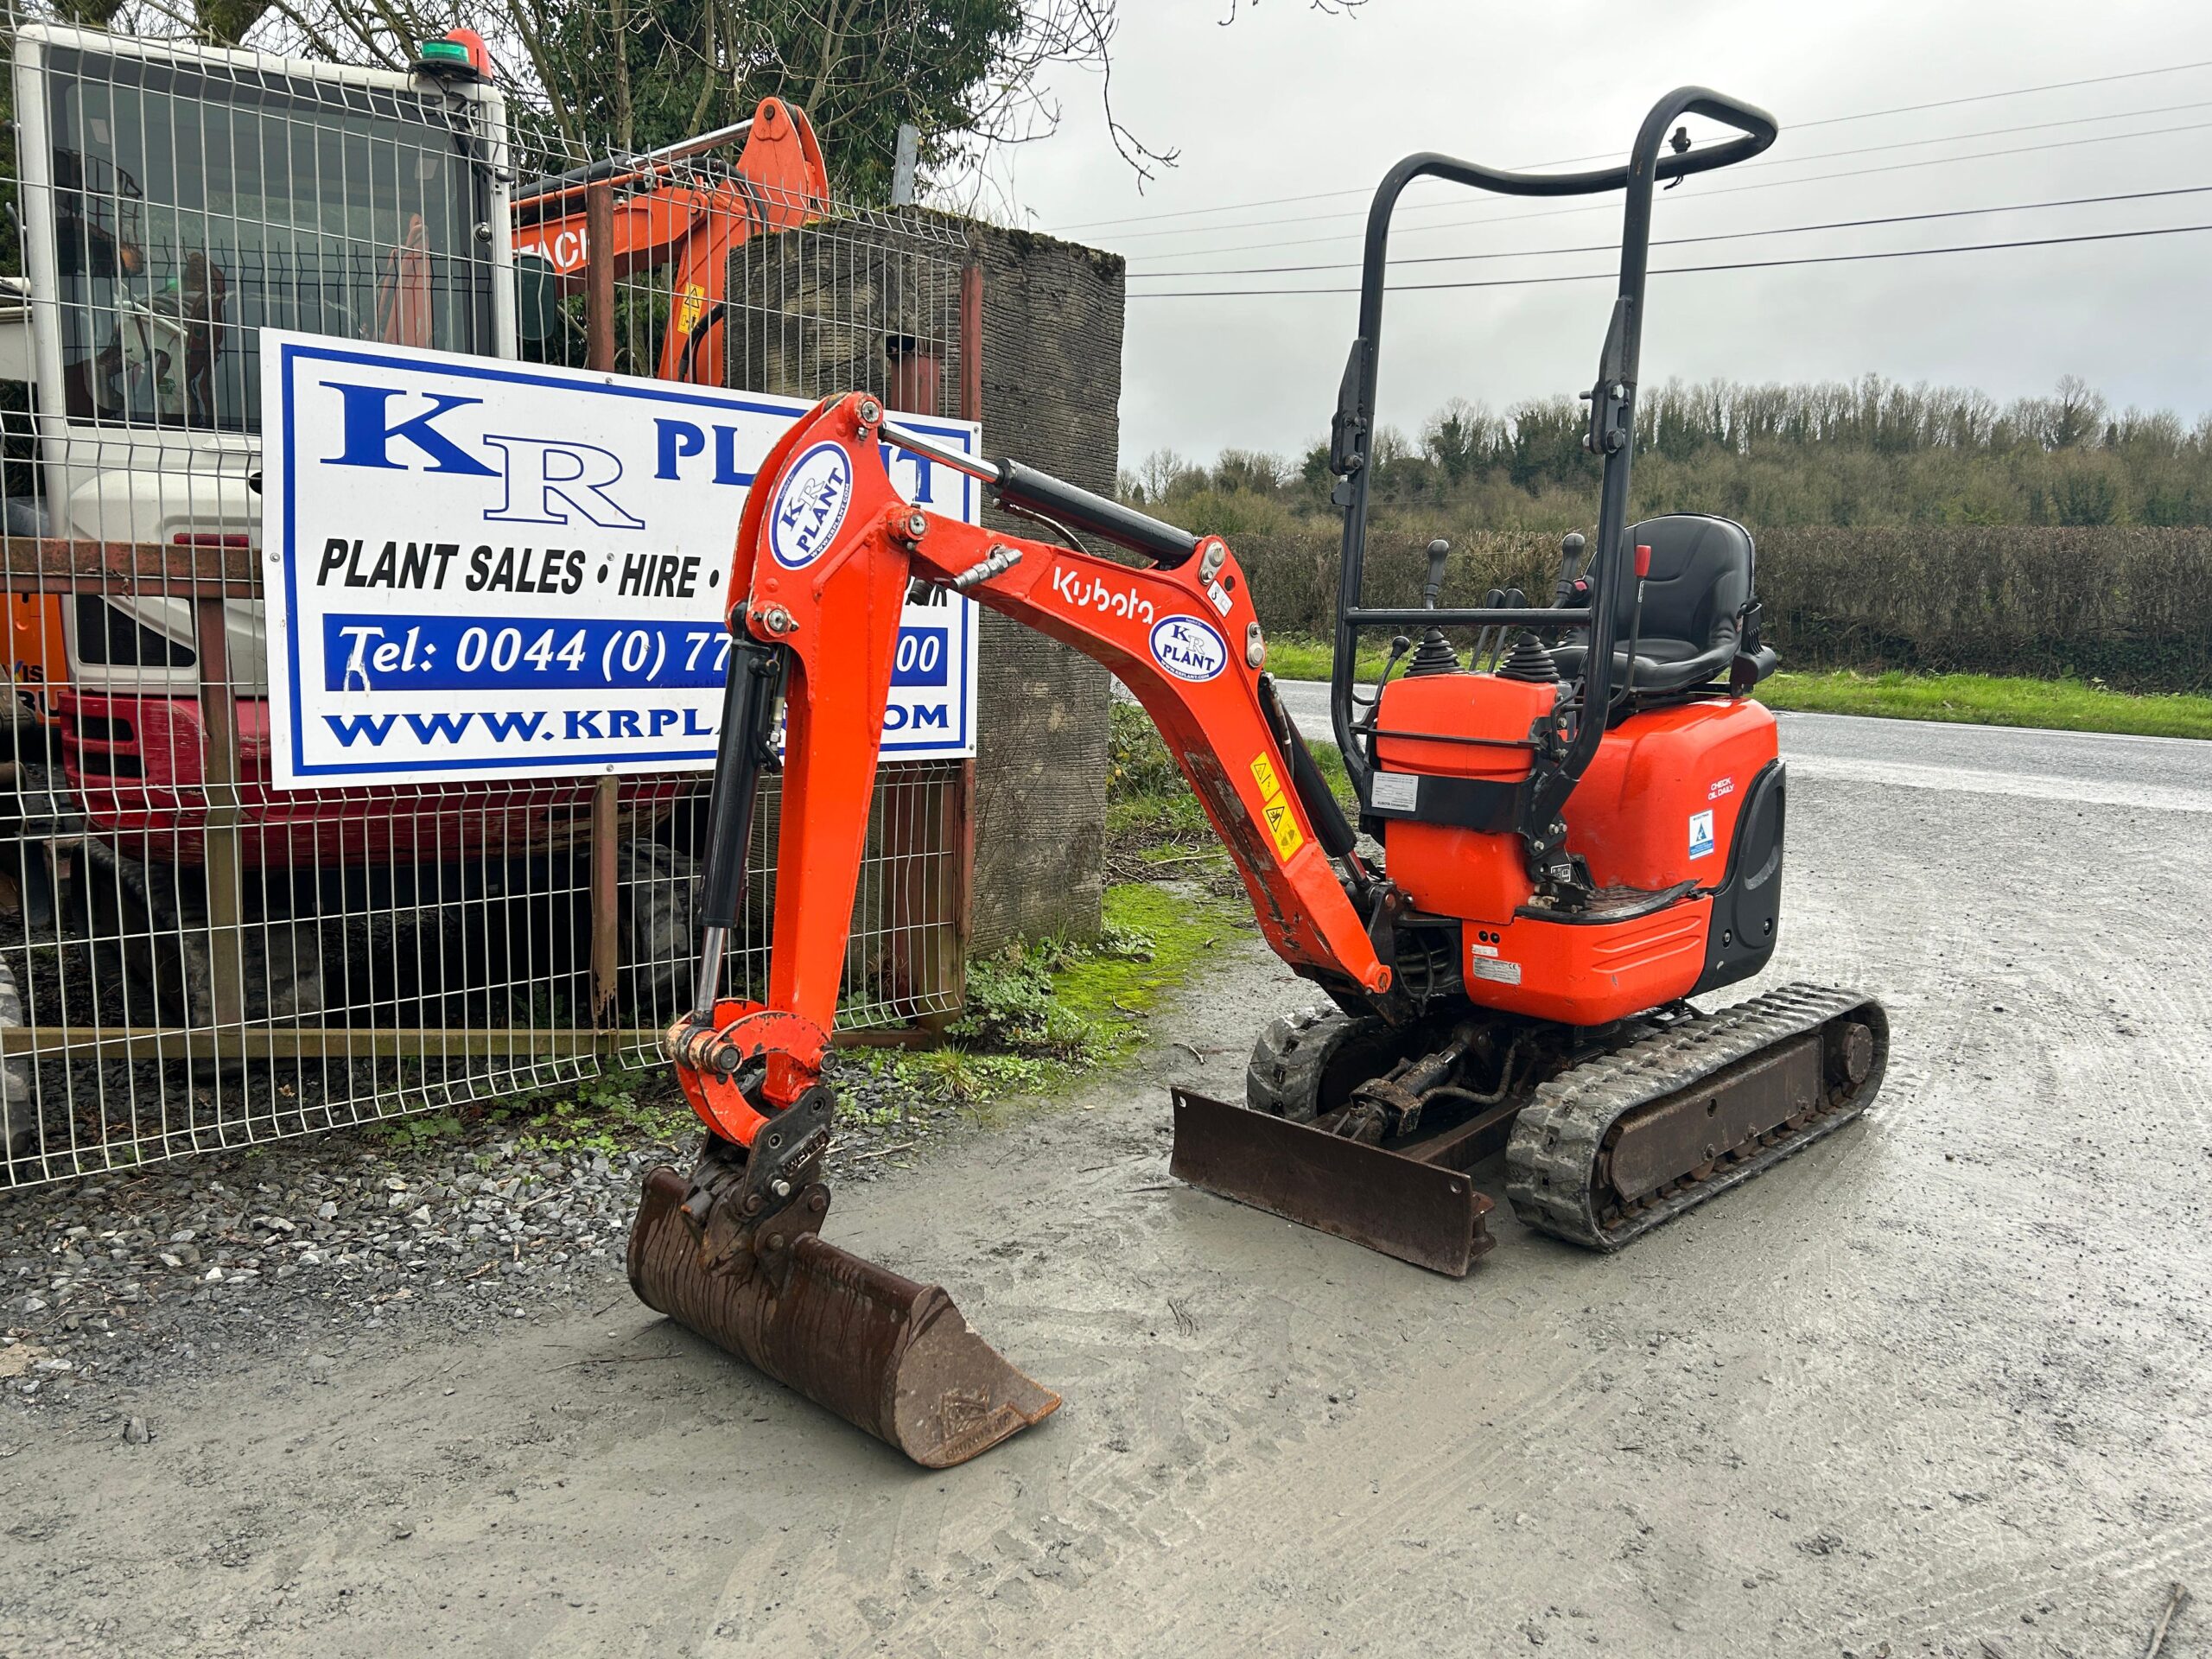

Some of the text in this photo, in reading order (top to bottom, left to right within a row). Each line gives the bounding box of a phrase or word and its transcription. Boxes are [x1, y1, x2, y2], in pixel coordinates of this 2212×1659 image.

[654, 418, 937, 504] PLT
[796, 467, 844, 554] PLANT
[316, 538, 701, 597] PLANT SALES HIRE
[1052, 566, 1154, 625] Kubota
[339, 626, 436, 673] Tel:
[455, 627, 586, 672] 0044
[602, 630, 666, 682] (0)
[1162, 644, 1215, 671] PLANT
[321, 704, 949, 747] WWW.KRPLOM
[1707, 784, 1734, 800] OIL DAILY
[1711, 777, 1732, 791] CHECK
